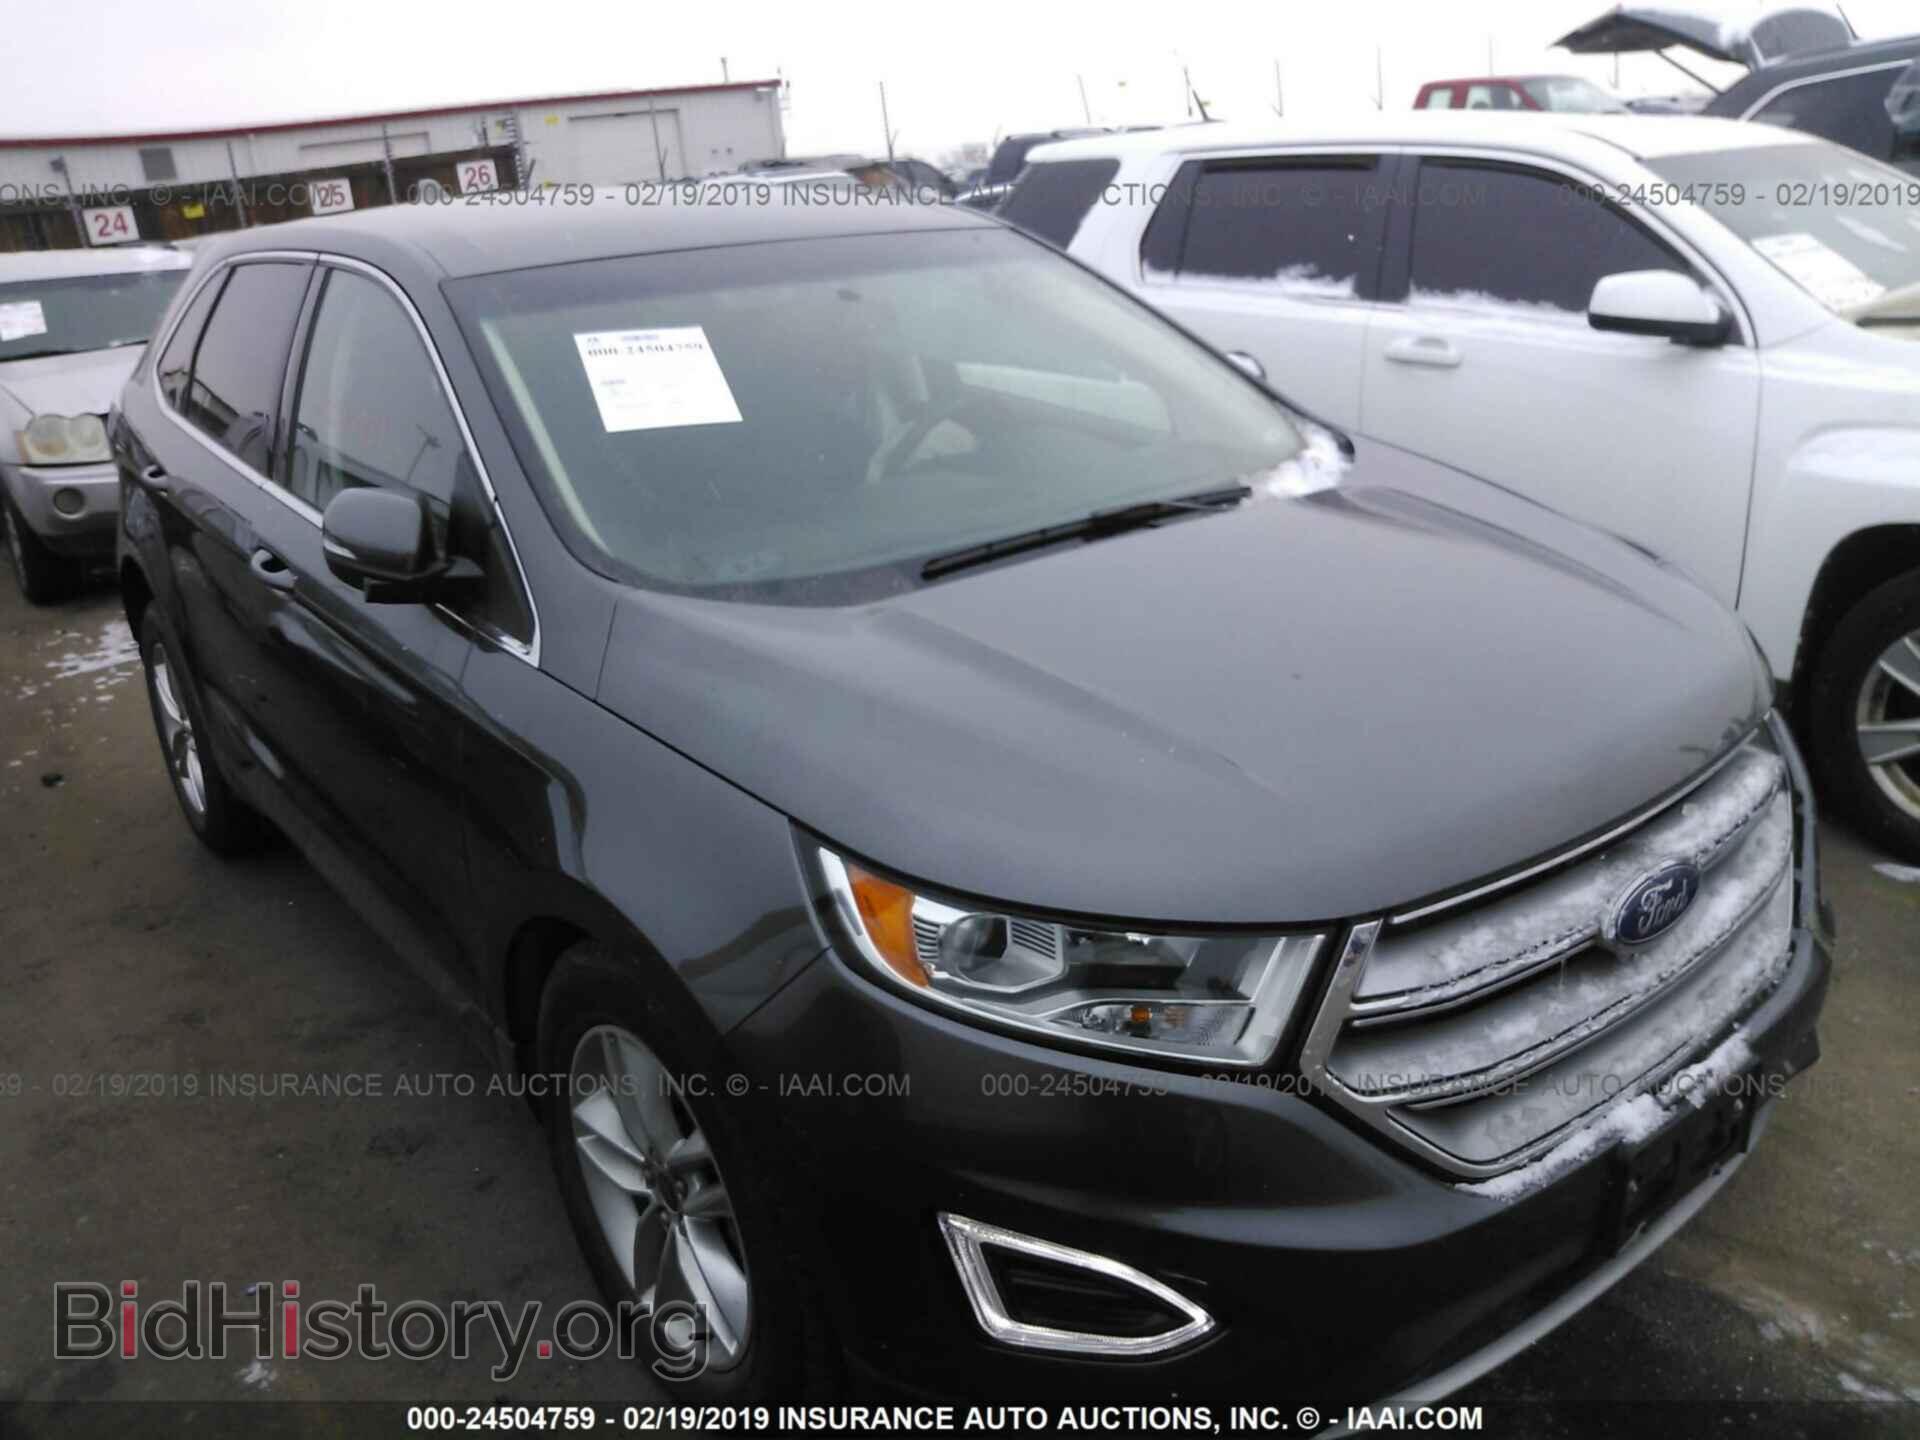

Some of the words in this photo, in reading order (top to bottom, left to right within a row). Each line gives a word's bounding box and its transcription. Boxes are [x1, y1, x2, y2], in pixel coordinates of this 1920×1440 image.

[464, 165, 491, 188] 26
[94, 212, 128, 237] 24
[1638, 877, 1687, 935] Ford
